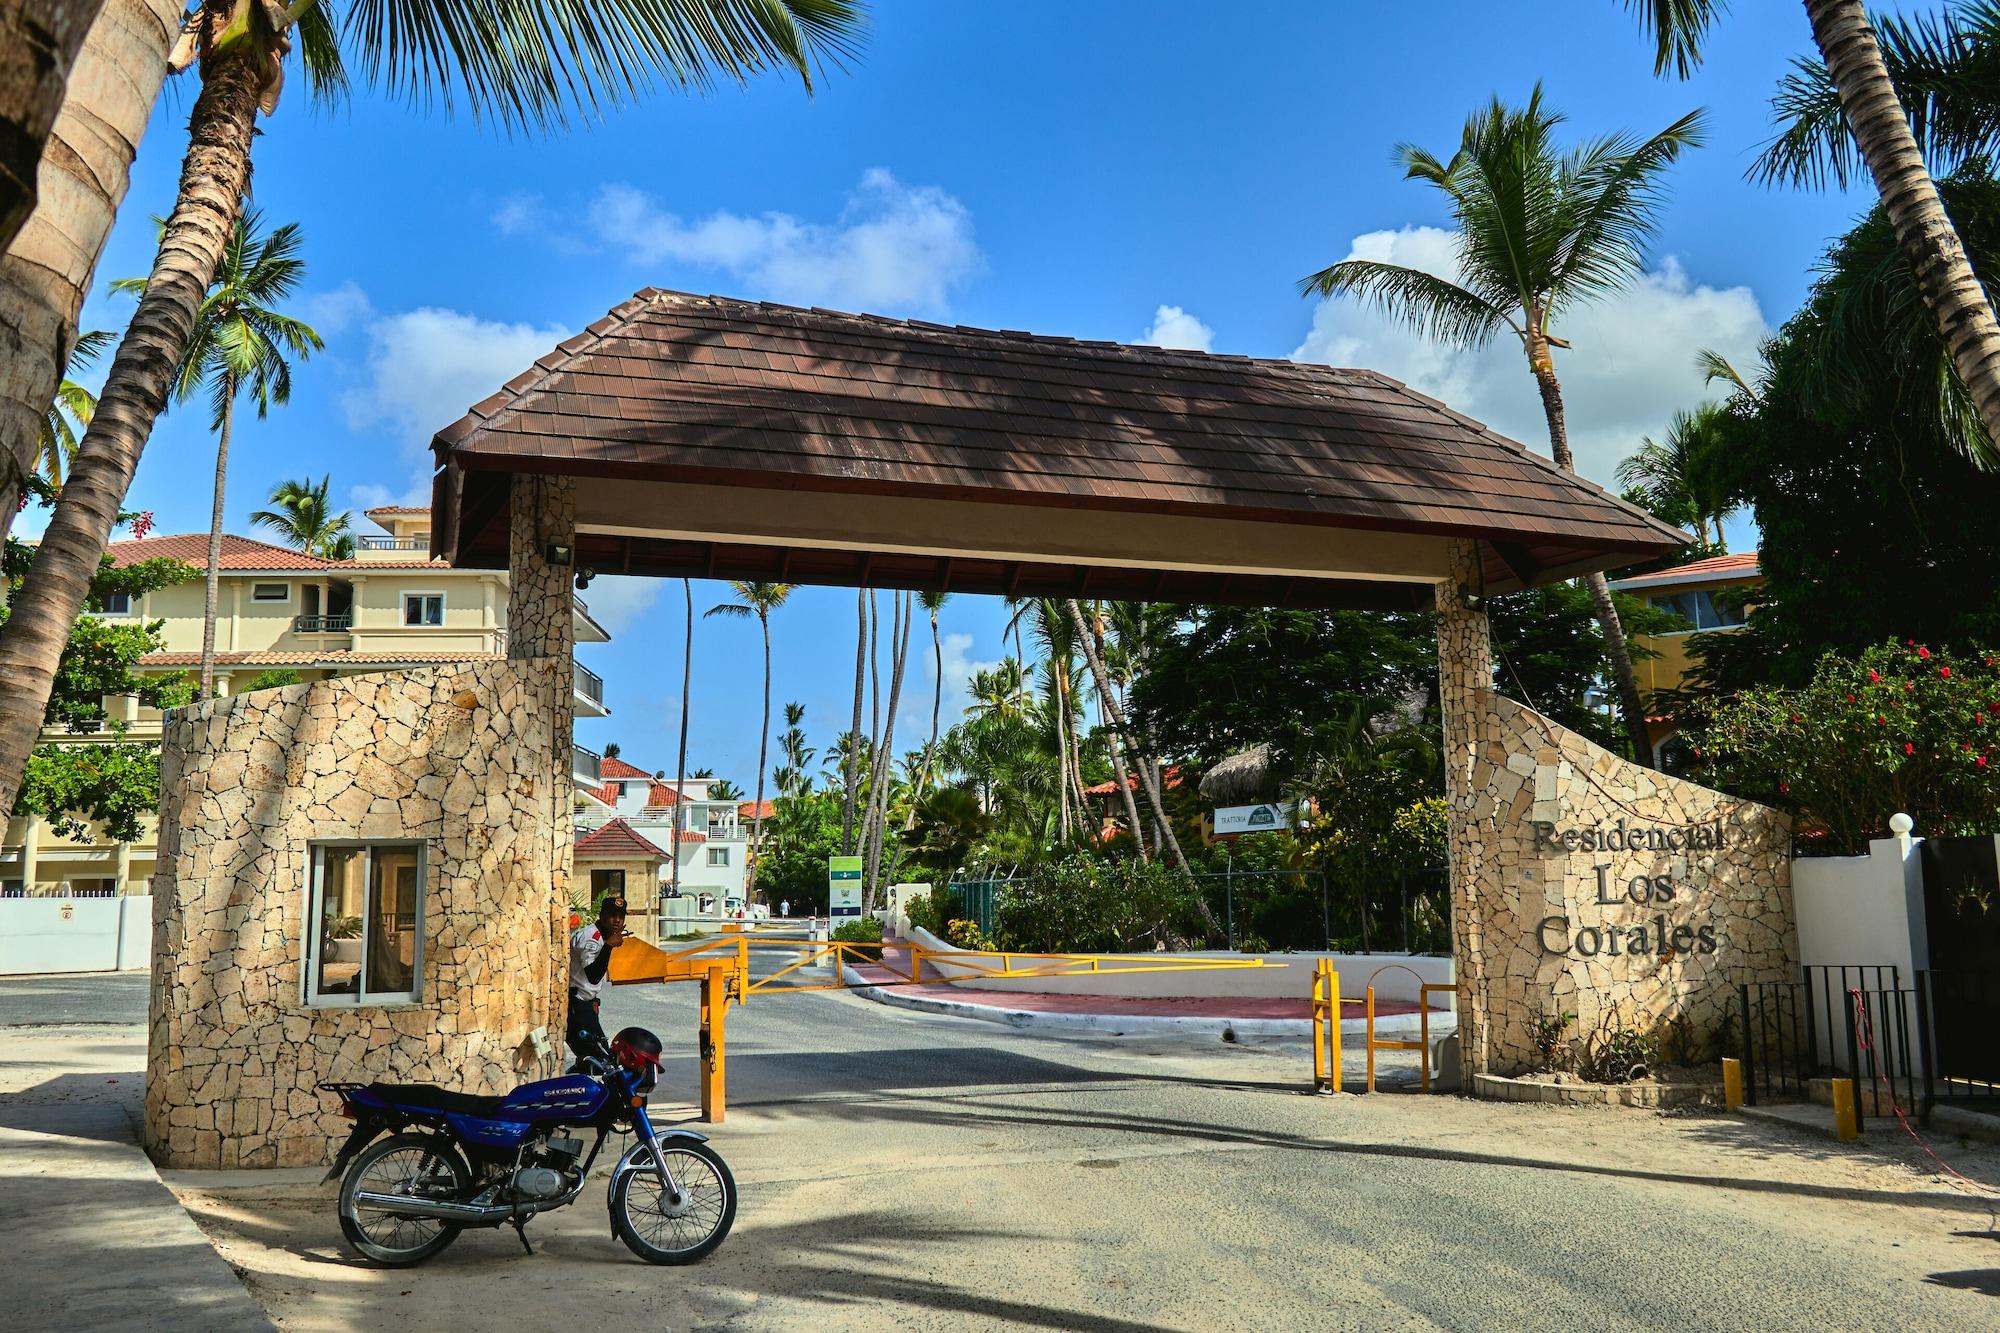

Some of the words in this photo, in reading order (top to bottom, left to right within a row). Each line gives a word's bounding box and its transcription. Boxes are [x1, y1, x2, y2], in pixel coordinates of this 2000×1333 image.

[1533, 816, 1724, 851] Residencial
[1593, 863, 1675, 905] Los
[1536, 914, 1717, 956] Corales
